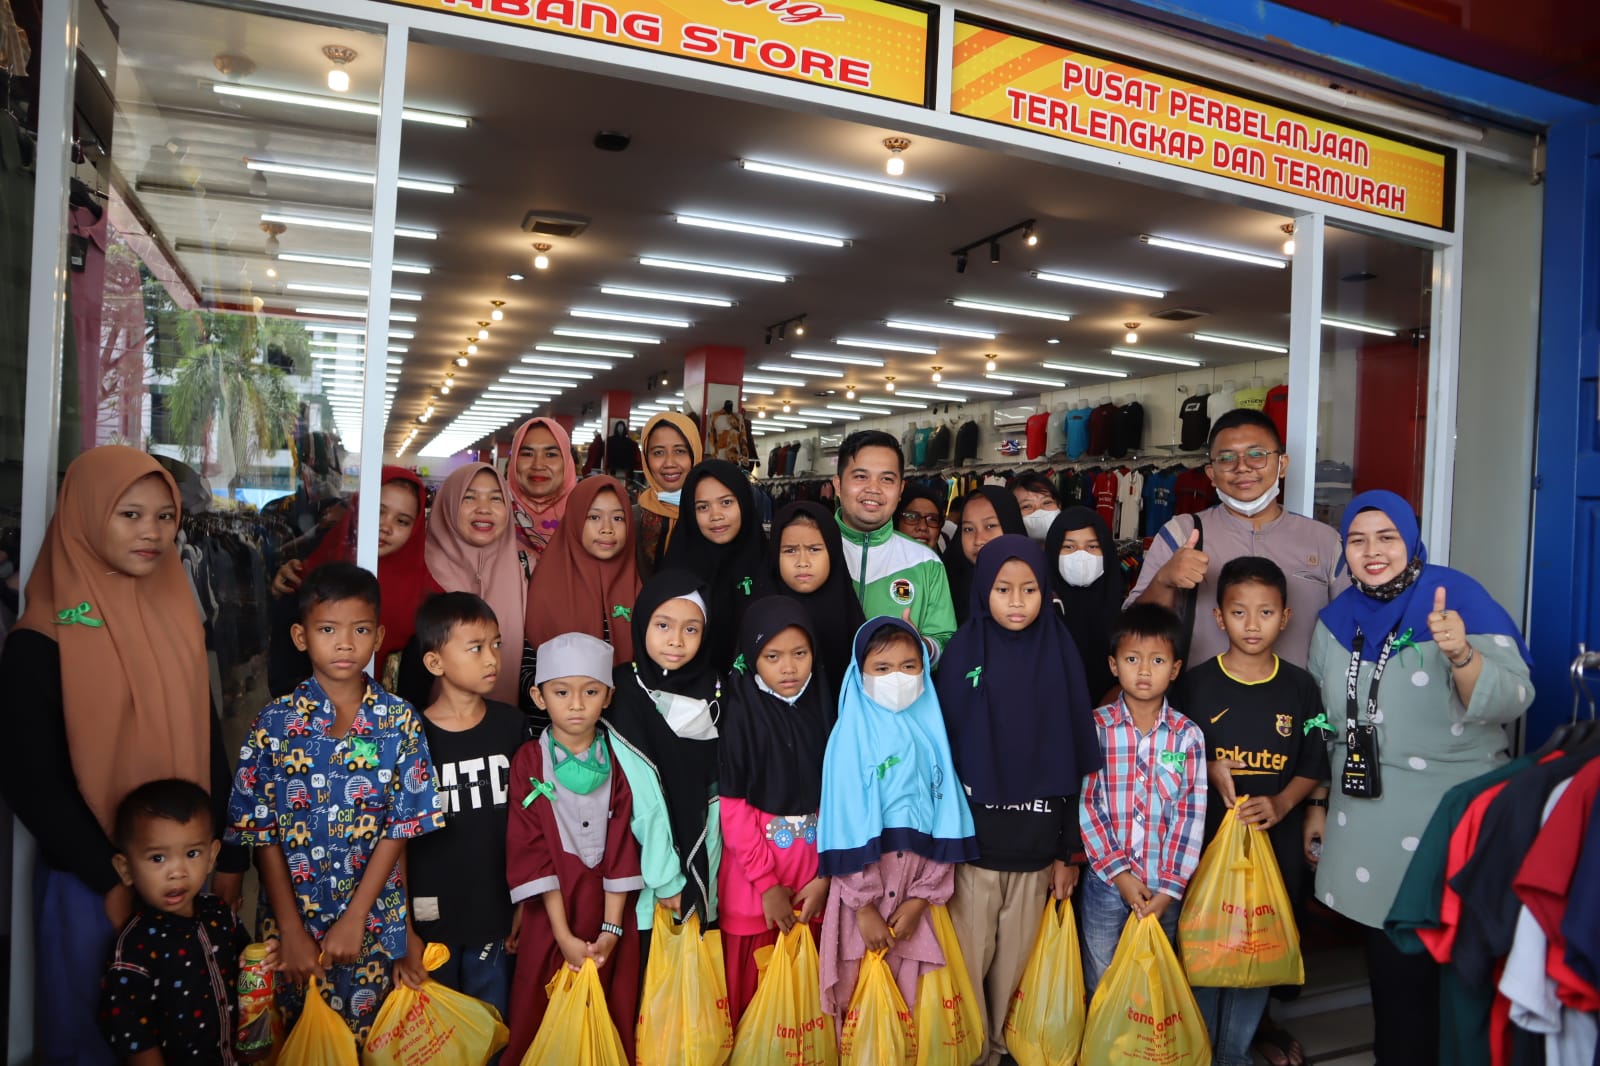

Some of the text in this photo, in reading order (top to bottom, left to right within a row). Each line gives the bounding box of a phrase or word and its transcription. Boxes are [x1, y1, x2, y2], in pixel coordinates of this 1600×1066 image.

[682, 25, 870, 87] STORE
[1063, 61, 1370, 167] PUSAT PERBELANJAAN
[1007, 89, 1406, 213] TERLENGKAP DAN TERMURAH
[305, 741, 320, 756] 23
[338, 808, 355, 822] car
[328, 823, 344, 838] big
[385, 891, 401, 909] car
